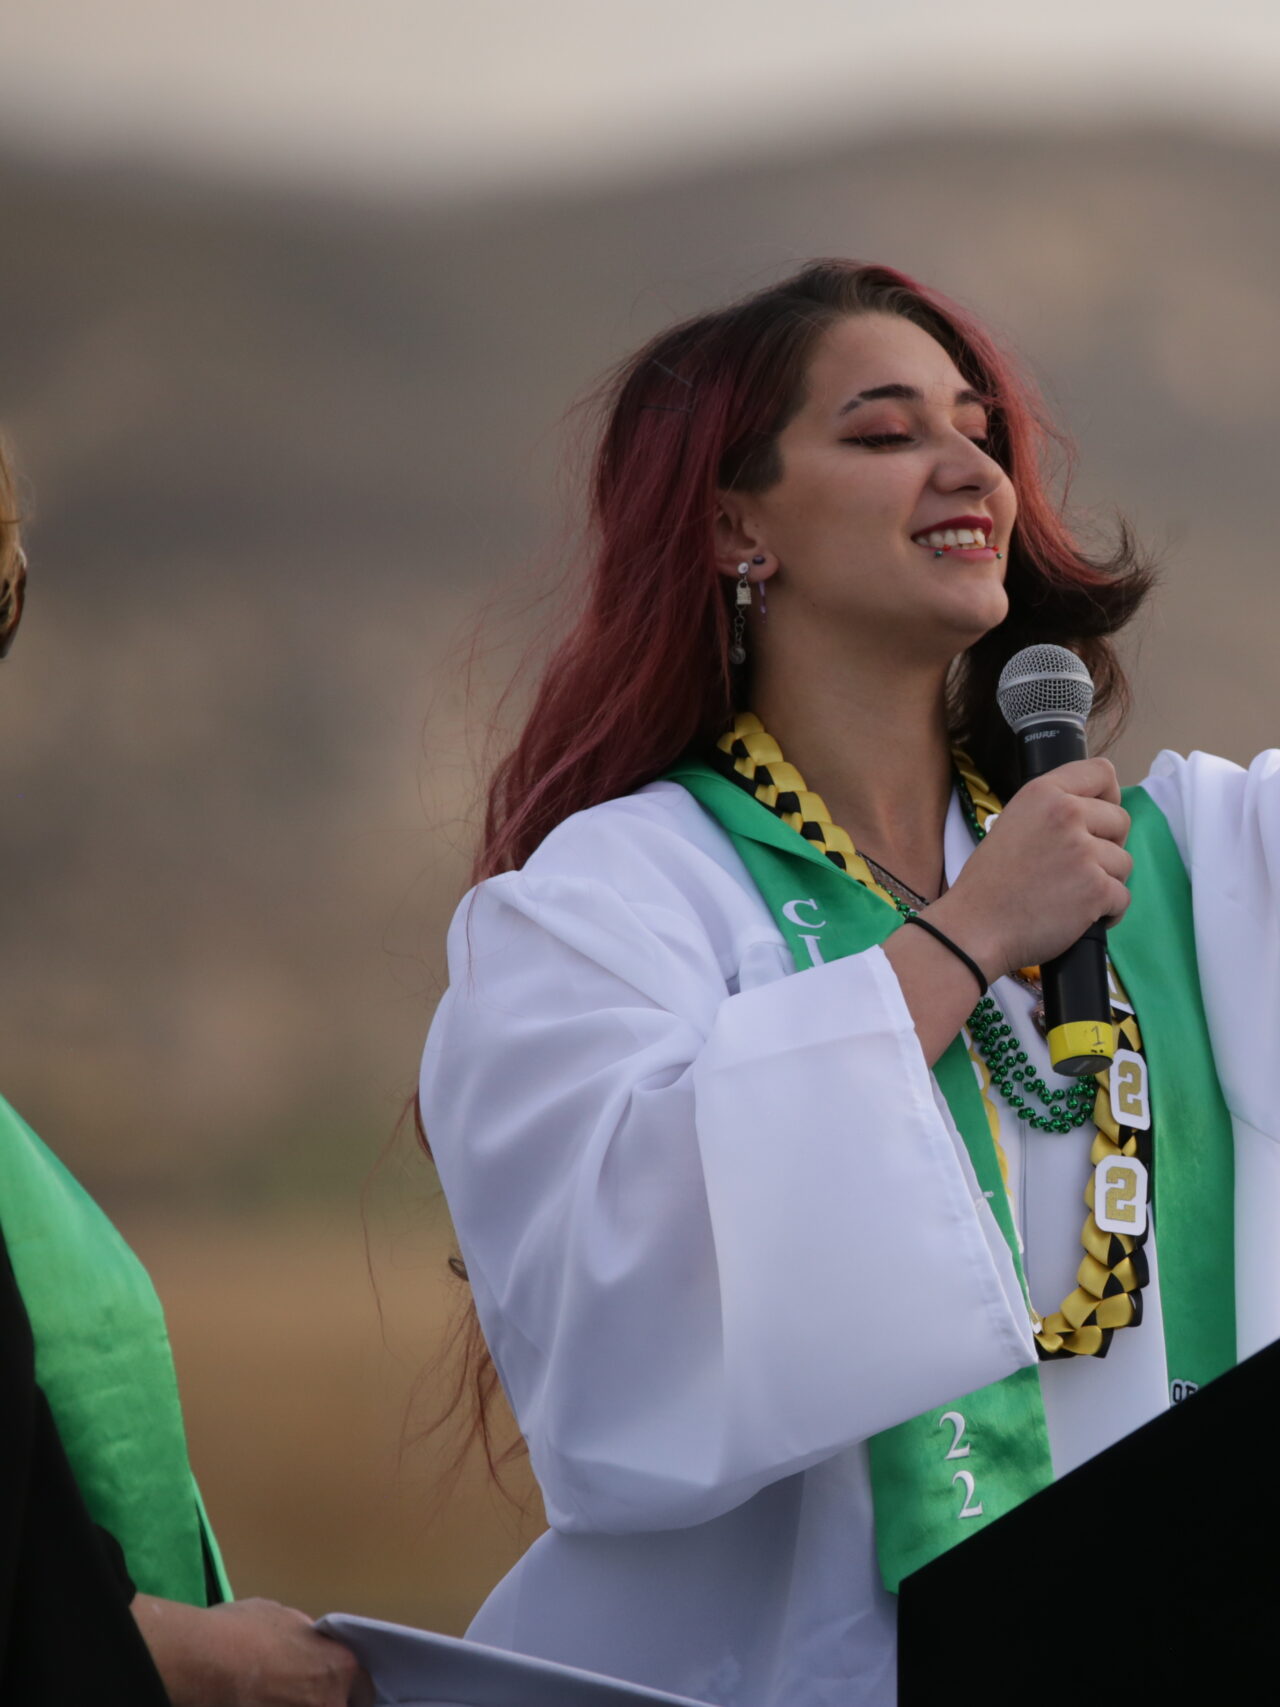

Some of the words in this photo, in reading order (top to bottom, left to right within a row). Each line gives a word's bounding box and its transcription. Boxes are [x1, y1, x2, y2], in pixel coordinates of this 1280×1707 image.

[1024, 729, 1057, 743] SHURE
[1091, 1024, 1105, 1047] 1
[1117, 1060, 1144, 1118] 2
[1104, 1166, 1137, 1223] 2
